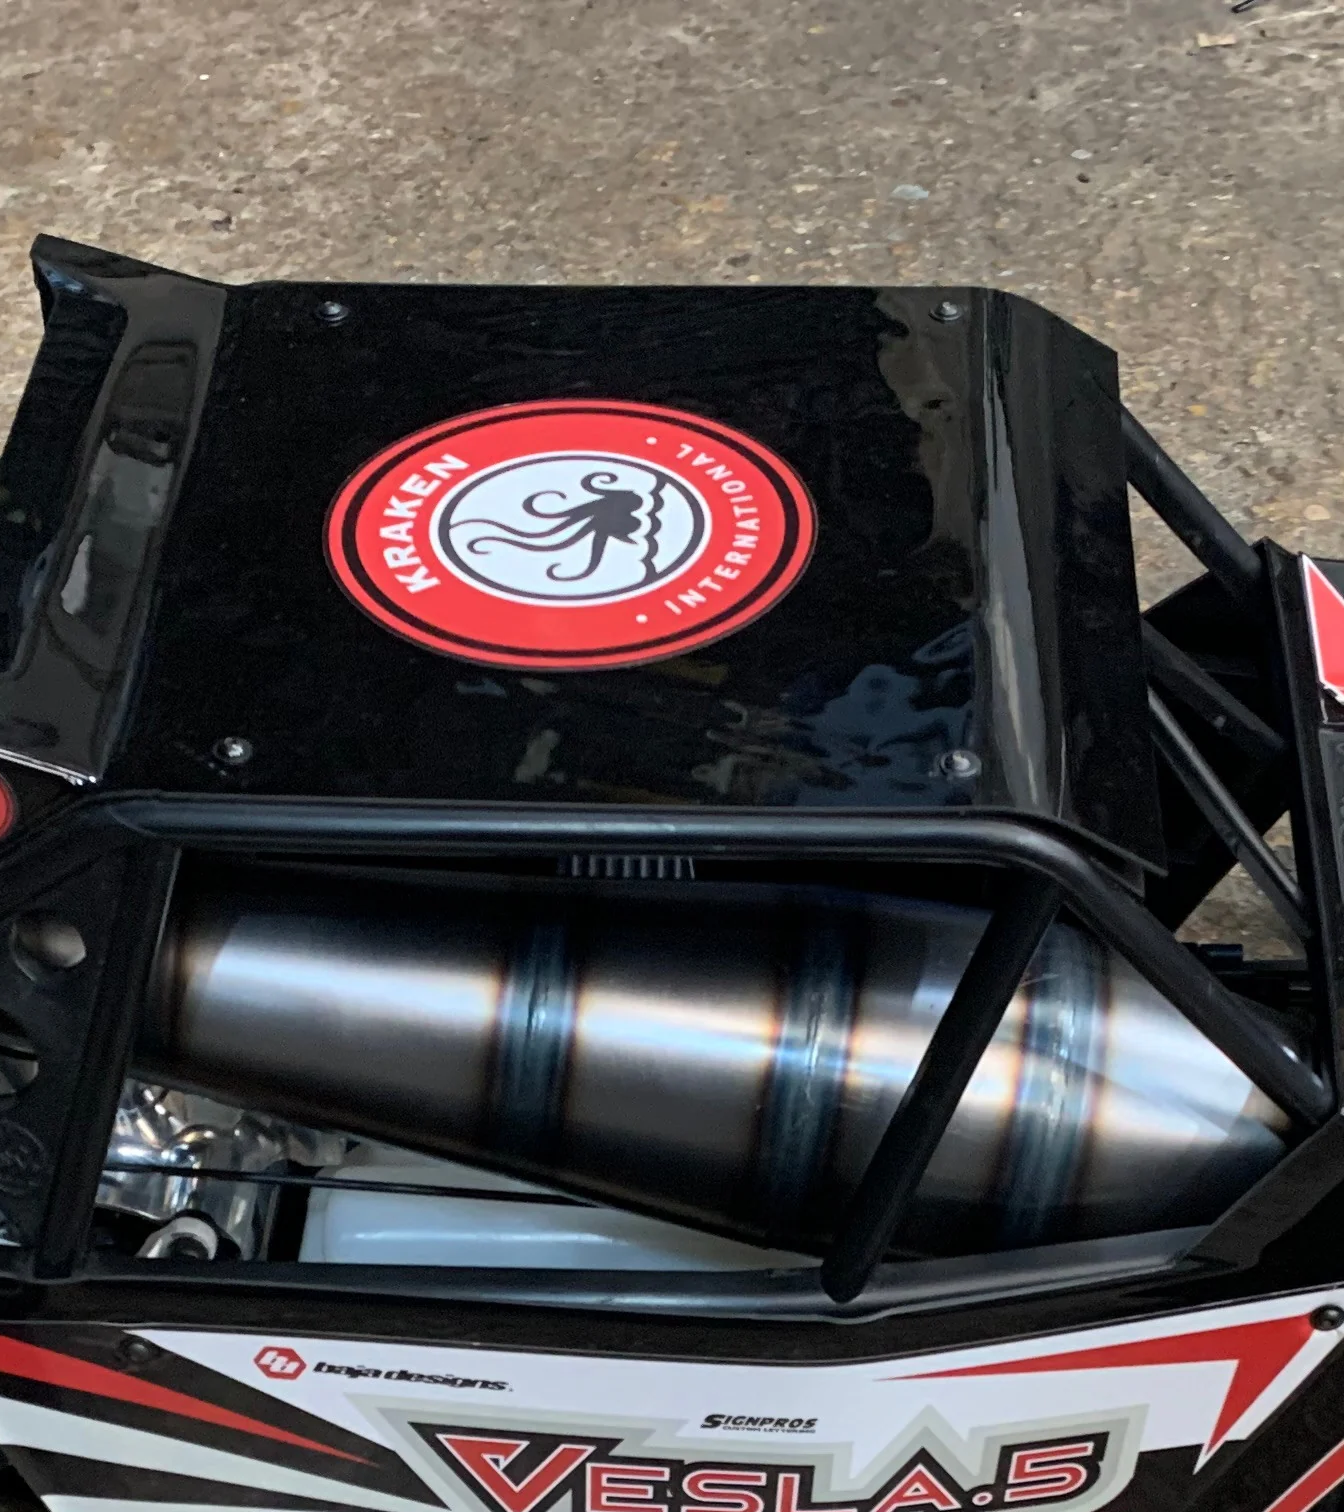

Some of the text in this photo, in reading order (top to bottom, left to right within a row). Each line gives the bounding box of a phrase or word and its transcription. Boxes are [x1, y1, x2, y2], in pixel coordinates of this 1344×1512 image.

[379, 453, 469, 595] KRAKEN
[664, 442, 761, 616] INTERNATIONAL
[313, 1361, 510, 1391] baja designs
[700, 1413, 818, 1429] SIGNPROS
